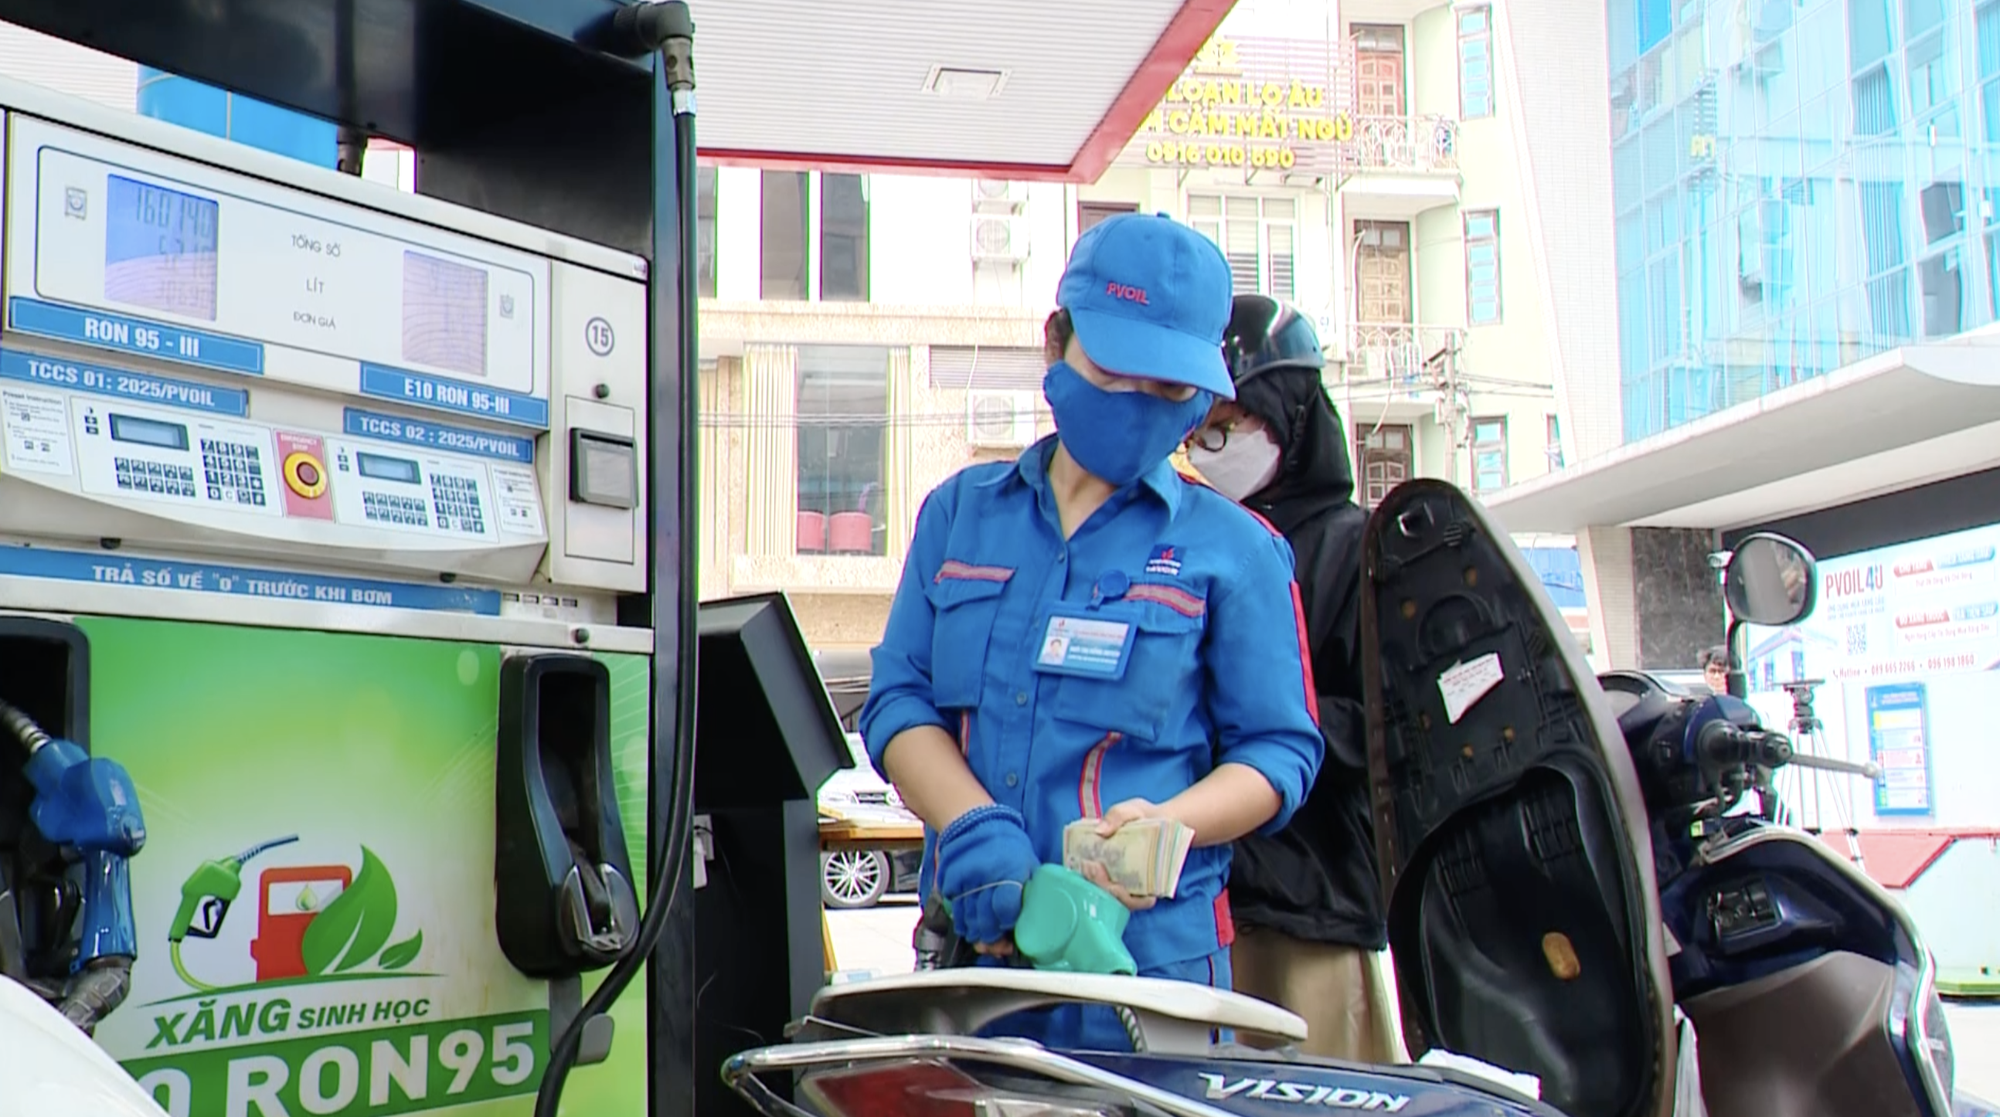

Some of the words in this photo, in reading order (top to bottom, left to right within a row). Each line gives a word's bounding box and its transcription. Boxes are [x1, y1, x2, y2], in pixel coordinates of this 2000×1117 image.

[291, 234, 321, 254] TỔNG
[326, 243, 341, 257] SỐ
[306, 279, 324, 294] LÍT
[1107, 282, 1150, 305] PVOIL
[85, 317, 129, 344] RON
[135, 328, 159, 348] 95
[180, 336, 200, 357] III
[318, 315, 336, 329] GIÁ
[592, 324, 609, 347] 15
[28, 360, 78, 383] TCCS
[117, 376, 215, 406] 2025/PVOIL
[404, 378, 433, 400] E10
[437, 382, 468, 406] RON
[360, 417, 401, 437] TCCS
[406, 424, 424, 440] 02
[438, 429, 520, 457] 2025/PVOIL
[92, 563, 135, 583] TRẢ
[142, 566, 171, 586] SỐ
[177, 569, 204, 589] VỀ
[246, 579, 309, 599] TRƯỚC
[315, 585, 346, 601] KHI
[352, 588, 393, 605] BƠM
[146, 999, 291, 1048] XĂNG
[297, 1004, 364, 1030] SINH
[373, 998, 430, 1025] HỌC
[1198, 1072, 1411, 1113] VISION
